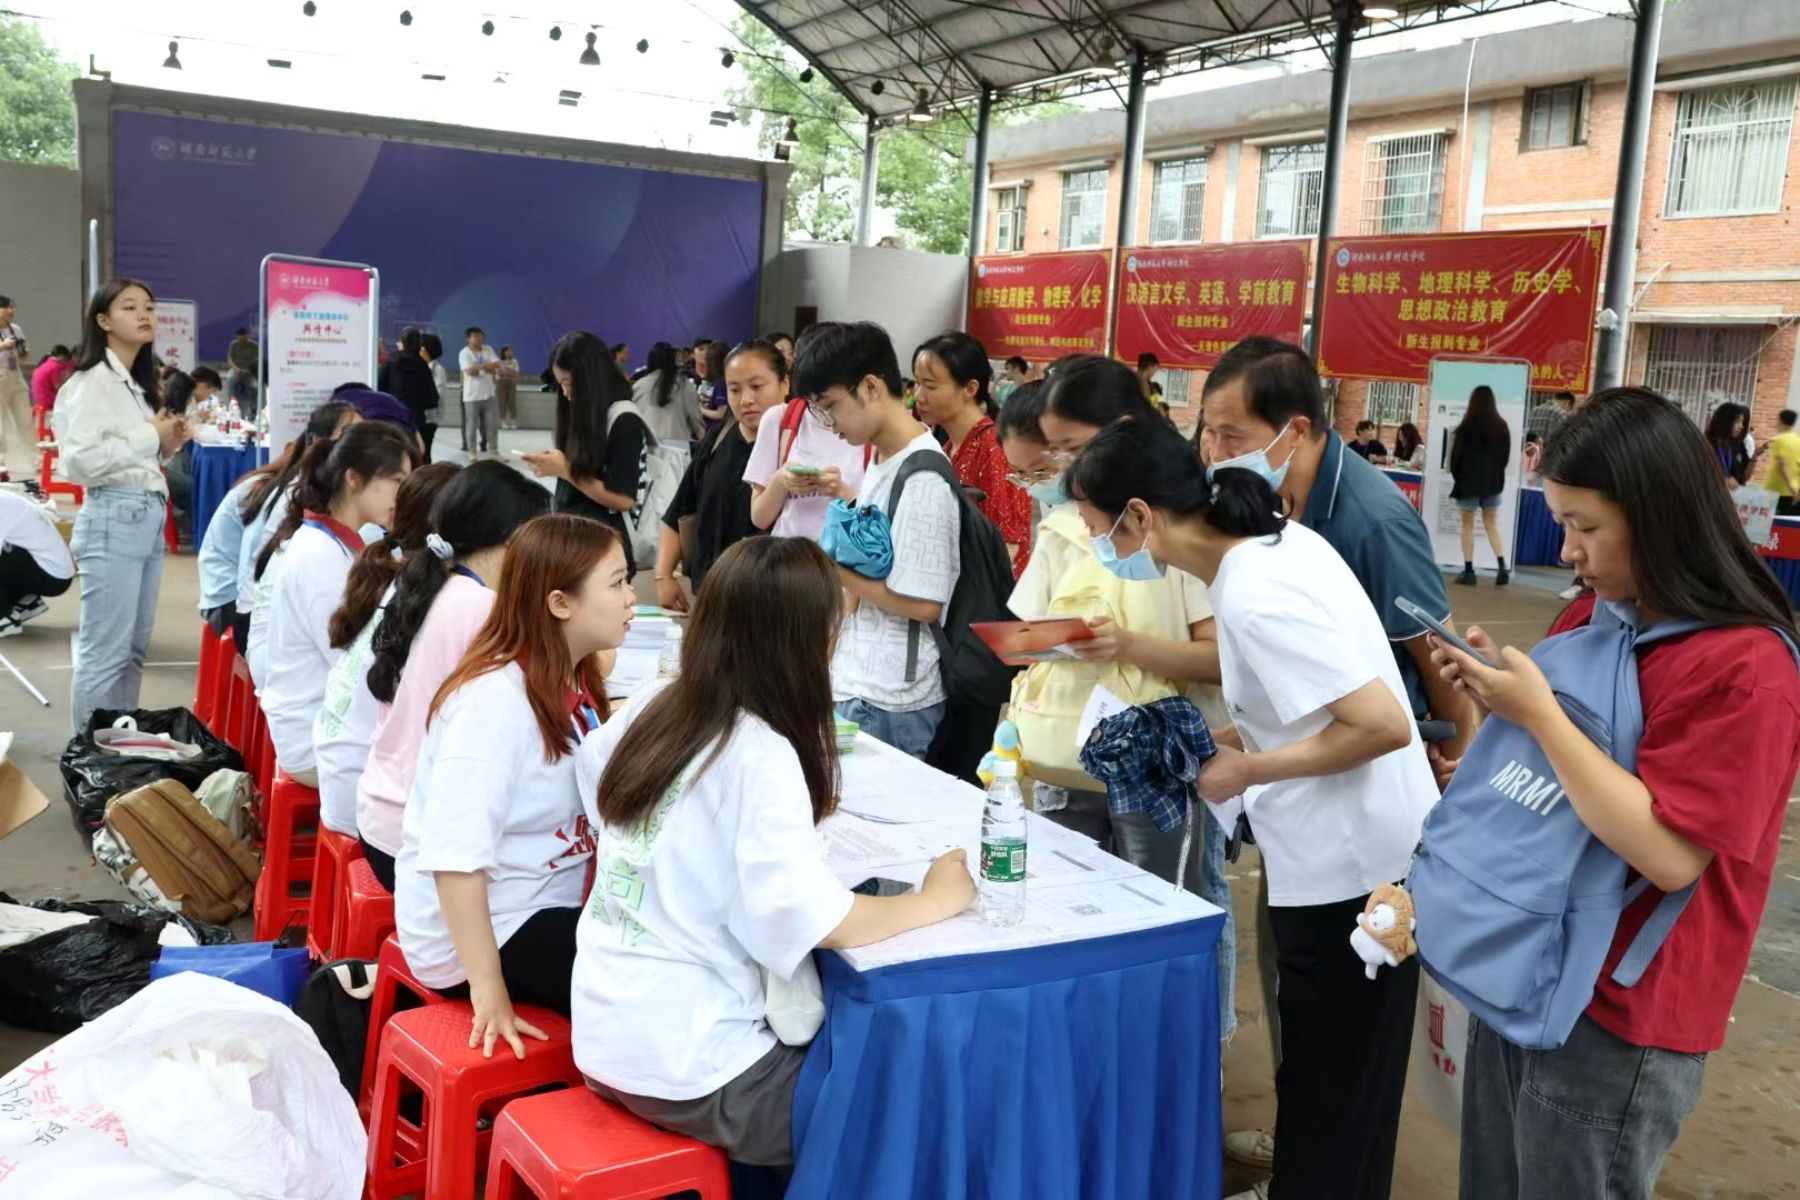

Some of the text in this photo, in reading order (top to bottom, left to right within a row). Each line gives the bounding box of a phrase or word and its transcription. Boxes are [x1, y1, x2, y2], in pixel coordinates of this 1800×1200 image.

[1398, 298, 1508, 324] 思想政治教育
[1489, 760, 1566, 816] MRMI
